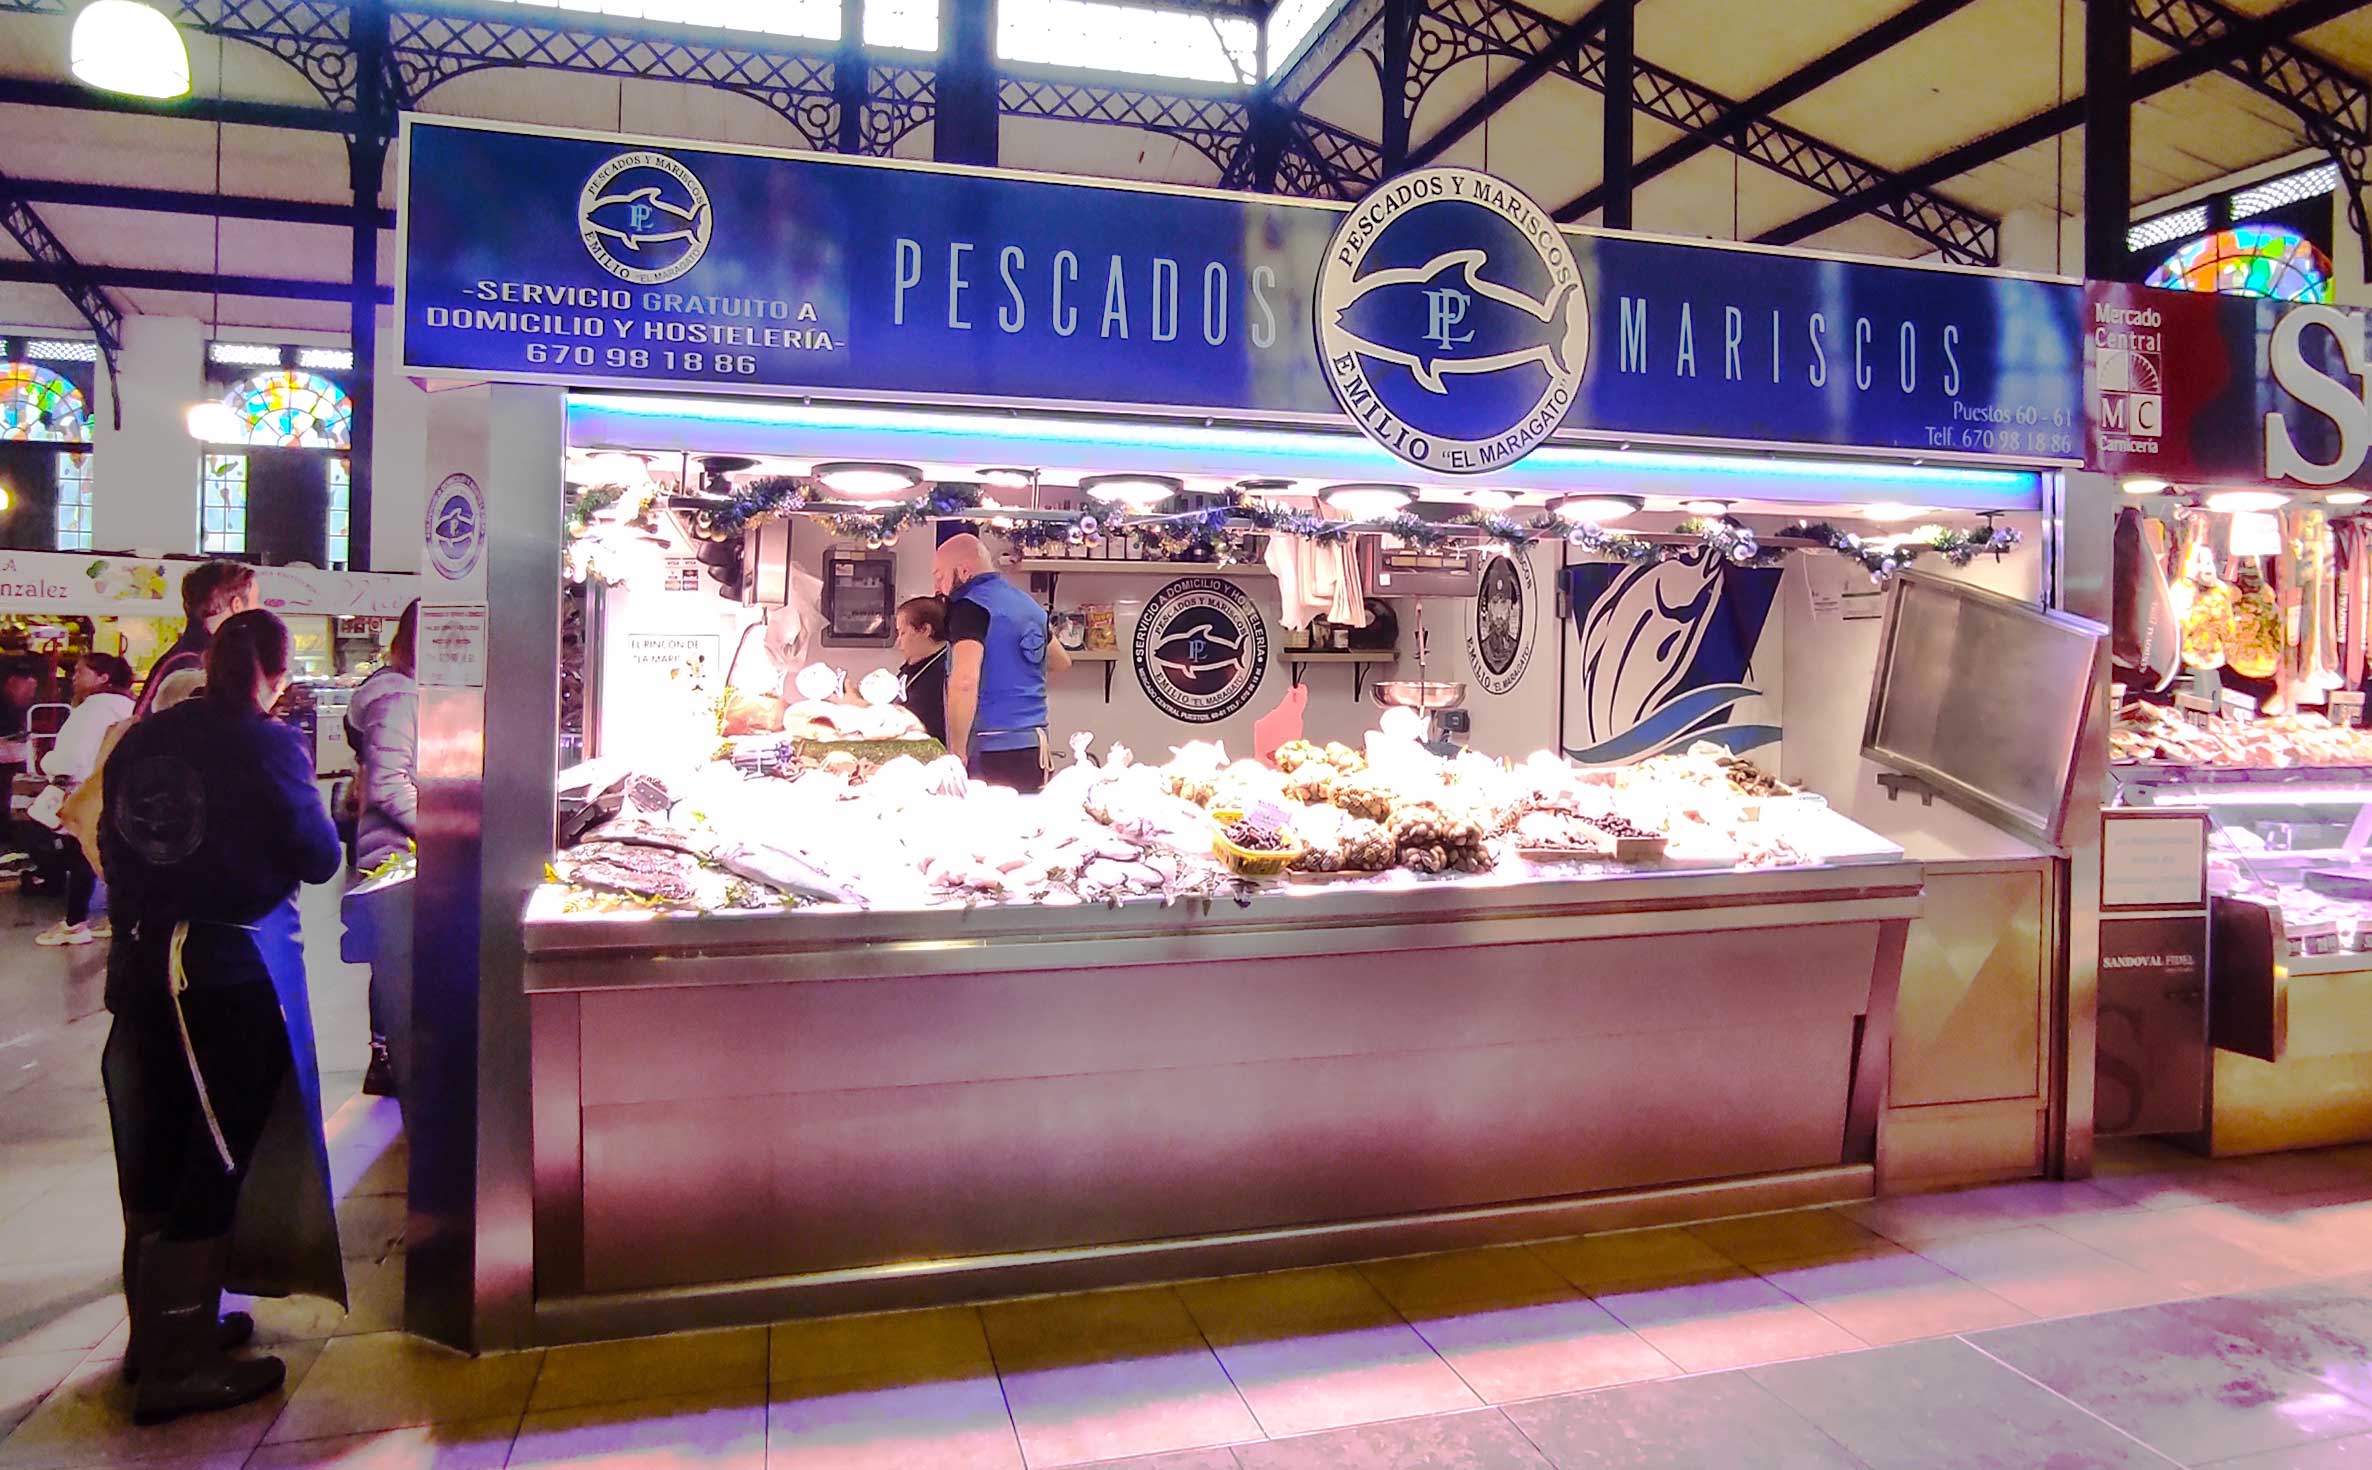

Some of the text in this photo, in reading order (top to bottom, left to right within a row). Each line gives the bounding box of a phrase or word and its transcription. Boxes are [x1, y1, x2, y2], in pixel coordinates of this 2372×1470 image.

[588, 155, 705, 204] PESCADOS Y MARISCOS
[1338, 176, 1572, 284] PESCADOS Y MARISCOS
[585, 231, 630, 278] EMILIO
[643, 292, 788, 320] GRATUITO
[798, 303, 818, 322] A
[893, 238, 1276, 348] PESCADOS
[427, 307, 604, 338] DOMICILIO
[615, 320, 634, 339] Y
[2095, 302, 2162, 328] Mercado
[1620, 297, 1960, 397] MARISCOS
[2095, 327, 2161, 351] Central
[526, 343, 757, 375] 670 98 18 86
[1333, 352, 1429, 461] EMILIO
[1953, 401, 2011, 424] Puestos
[2016, 406, 2037, 425] 60
[2053, 407, 2071, 427] 61
[1925, 426, 2072, 454] Telf. 670 98 18 86
[1135, 602, 1159, 657] SERVICIO
[1159, 595, 1168, 605] A
[1166, 579, 1221, 598] DOMICILIO
[1223, 585, 1231, 595] Y
[1155, 598, 1196, 635] PESCADOS
[1208, 598, 1247, 637] MARISCOS
[1156, 672, 1189, 703] EMILIO
[2103, 955, 2162, 969] SANDOVAL
